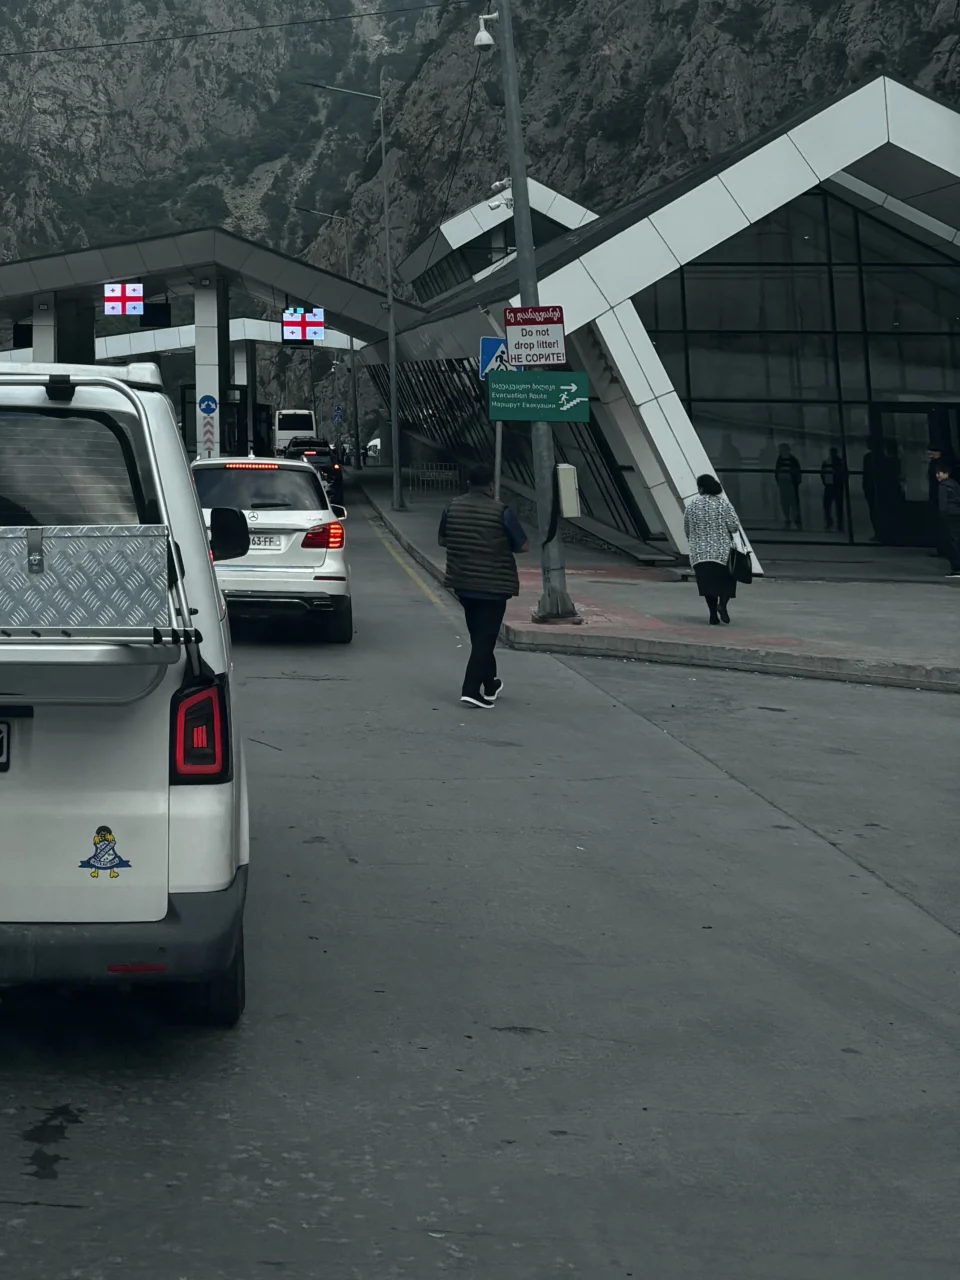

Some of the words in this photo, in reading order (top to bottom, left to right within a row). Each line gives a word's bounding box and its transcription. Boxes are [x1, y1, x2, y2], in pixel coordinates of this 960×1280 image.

[521, 328, 533, 337] Do
[536, 327, 550, 337] not
[514, 340, 534, 351] drop
[536, 339, 559, 349] litter!
[510, 353, 523, 363] НЕ
[525, 352, 565, 363] СОРИТЕ!
[491, 391, 528, 400] Evacuation
[528, 392, 548, 400] Route
[491, 401, 521, 409] Маршрут
[251, 536, 274, 546] 63-FF
